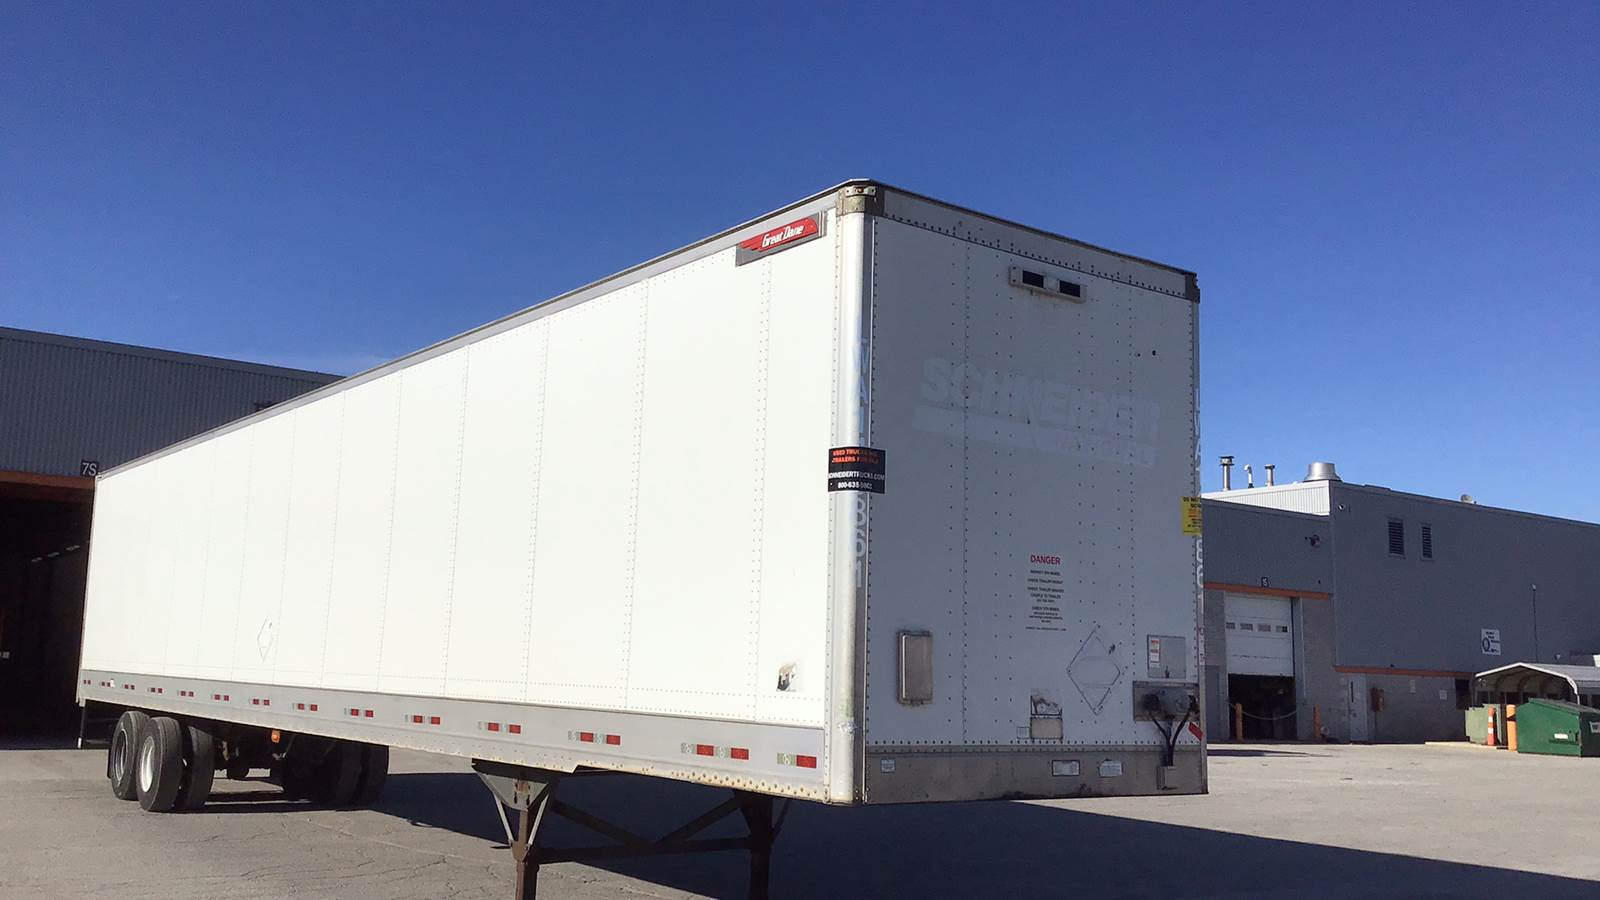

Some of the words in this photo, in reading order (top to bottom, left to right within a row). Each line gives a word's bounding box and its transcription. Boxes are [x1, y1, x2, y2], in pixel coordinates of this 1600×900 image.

[761, 231, 784, 248] Great
[782, 225, 805, 241] Dane
[919, 358, 1161, 441] SCHNEIDER
[82, 462, 97, 476] 7S
[1030, 554, 1061, 565] DANGER
